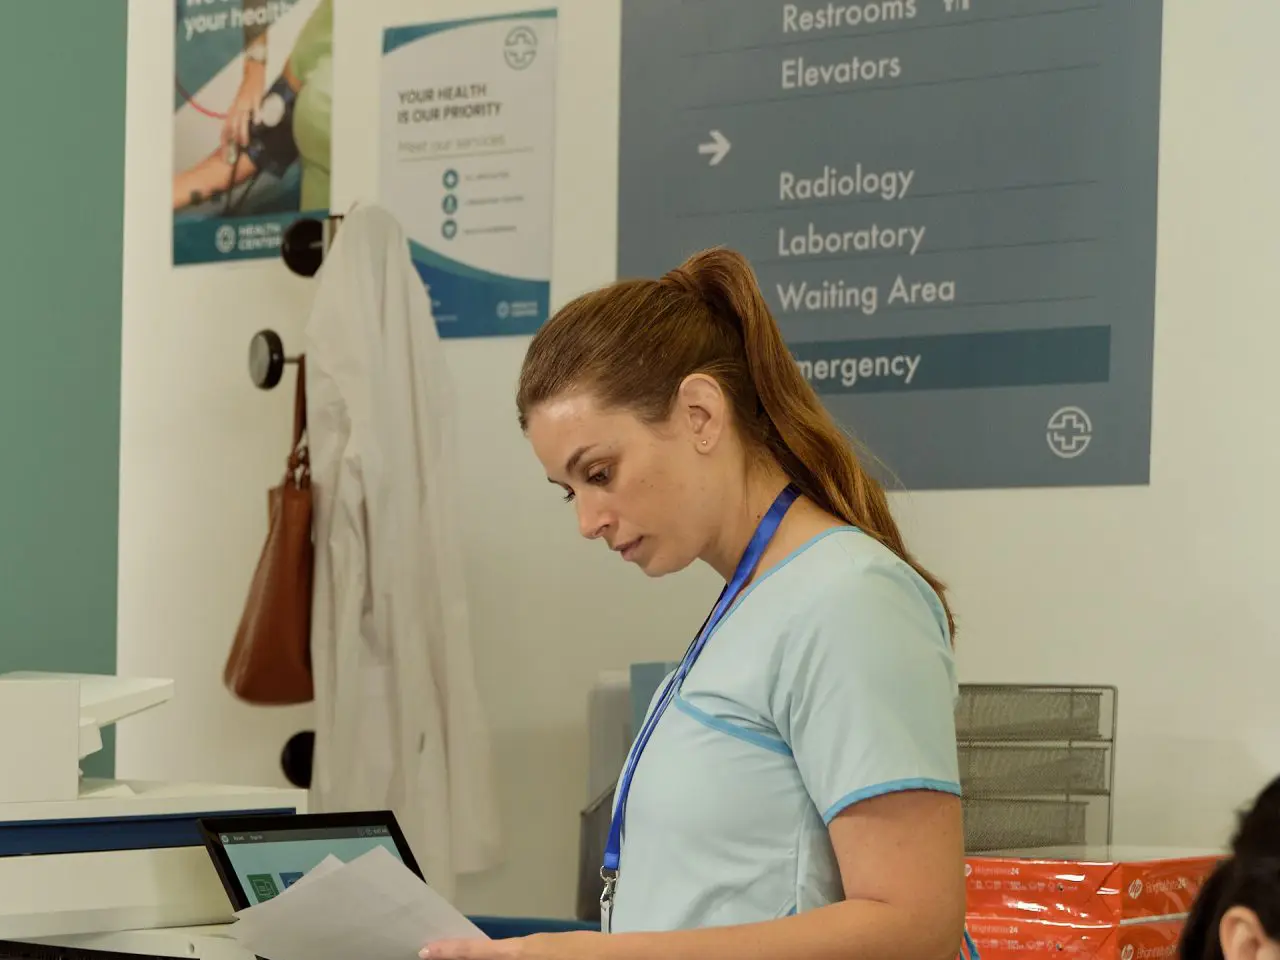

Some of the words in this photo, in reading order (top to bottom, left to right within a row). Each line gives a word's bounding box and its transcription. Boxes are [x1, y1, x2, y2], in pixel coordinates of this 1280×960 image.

[183, 12, 229, 42] your
[782, 0, 917, 33] Restrooms
[781, 56, 901, 89] Elevators
[398, 89, 435, 105] YOUR
[438, 83, 487, 101] HEALTH
[397, 110, 410, 125] IS
[412, 106, 441, 124] OUR
[443, 101, 503, 121] PRIORITY
[779, 162, 915, 201] Radiology
[778, 222, 927, 257] Laboratory
[776, 279, 878, 315] Waiting
[887, 274, 957, 306] Area
[795, 353, 922, 387] mergency
